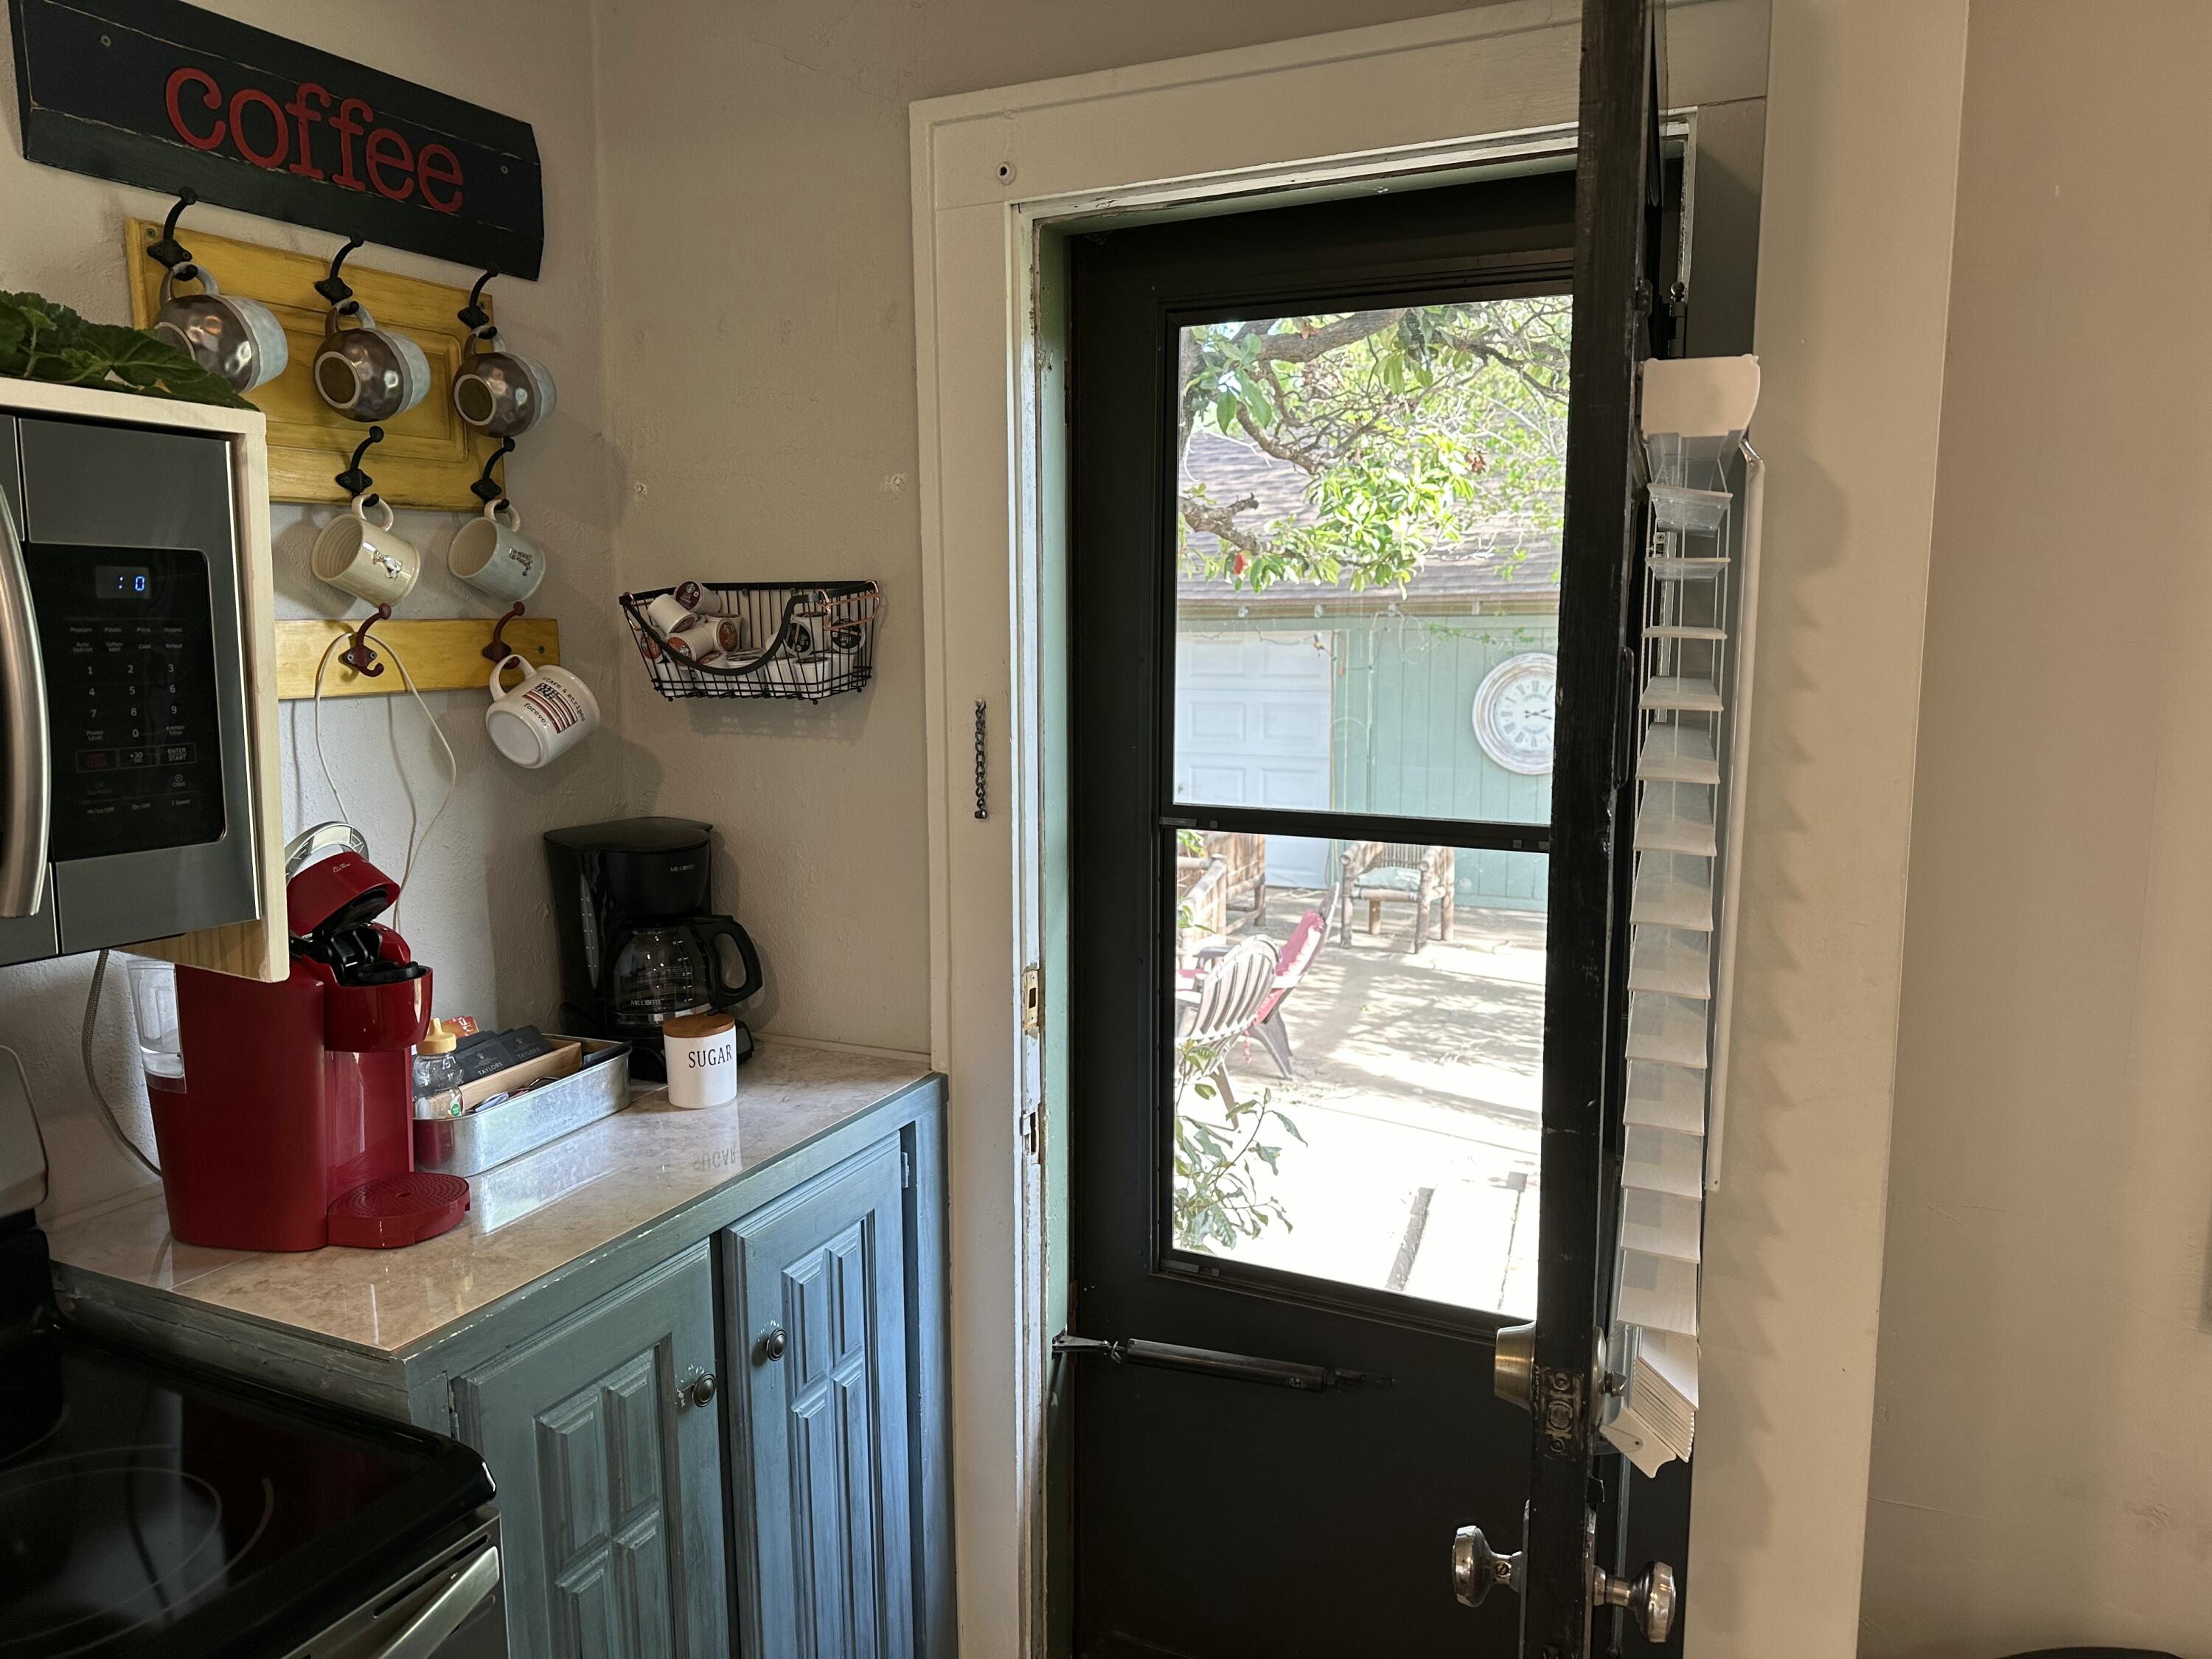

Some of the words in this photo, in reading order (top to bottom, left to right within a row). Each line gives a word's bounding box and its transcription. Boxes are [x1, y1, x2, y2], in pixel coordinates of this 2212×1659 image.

[166, 68, 463, 214] coffee
[87, 666, 93, 675] 1
[128, 664, 134, 673] 2
[168, 664, 175, 672] 3
[88, 687, 95, 696] 4
[129, 686, 136, 695] 5
[170, 684, 176, 693] 6
[90, 709, 97, 718] 7
[131, 708, 137, 717] 8
[171, 706, 177, 714] 9
[132, 728, 139, 737] 0
[517, 1047, 541, 1060] TAYLORS
[688, 1044, 732, 1068] SUGAR
[477, 1061, 503, 1076] TAYLORS
